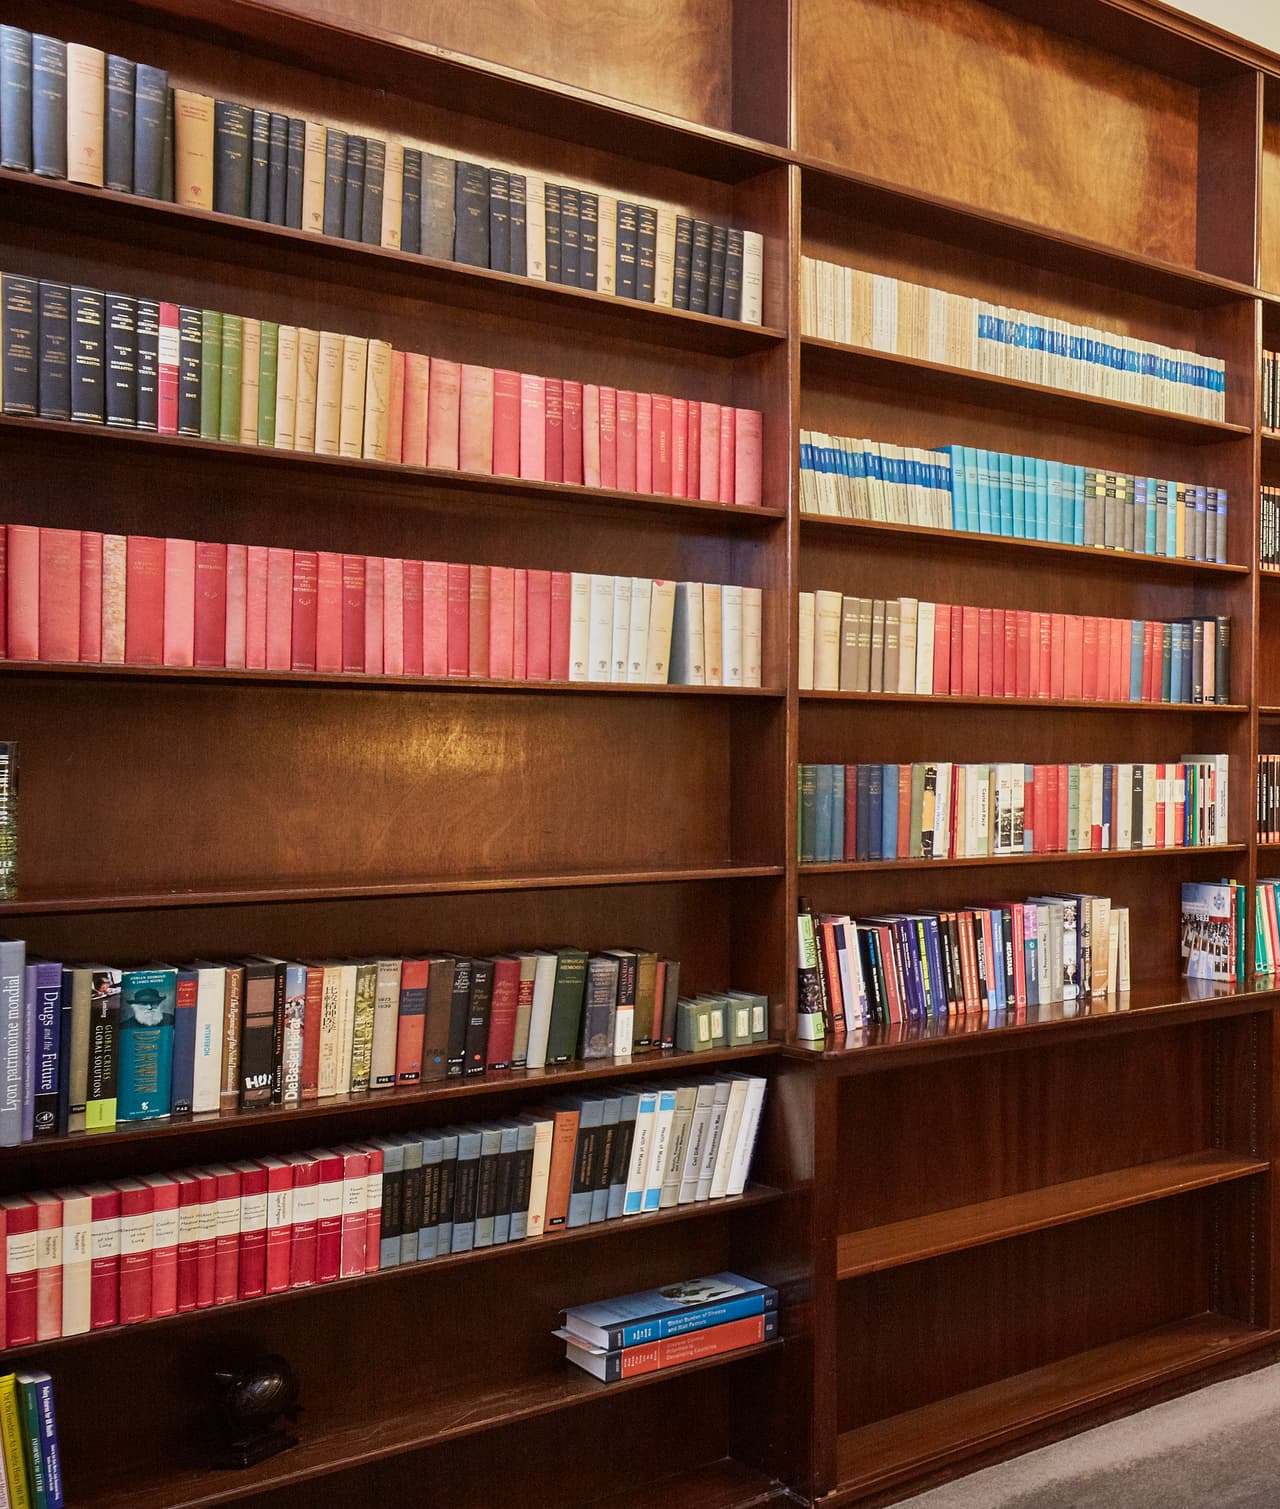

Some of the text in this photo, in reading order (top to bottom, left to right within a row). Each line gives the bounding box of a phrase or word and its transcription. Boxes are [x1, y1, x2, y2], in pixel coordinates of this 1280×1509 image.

[1, 975, 21, 1112] Lyon patrimoine mondial
[39, 992, 58, 1090] Drugs and the Future
[93, 1025, 103, 1098] GLOBAL SOLUTIONS
[104, 1024, 113, 1049] GLOBAL
[133, 1029, 160, 1094] DARWIN
[203, 1023, 212, 1057] INTERFERON
[285, 1018, 301, 1101] Die Basler Heirat
